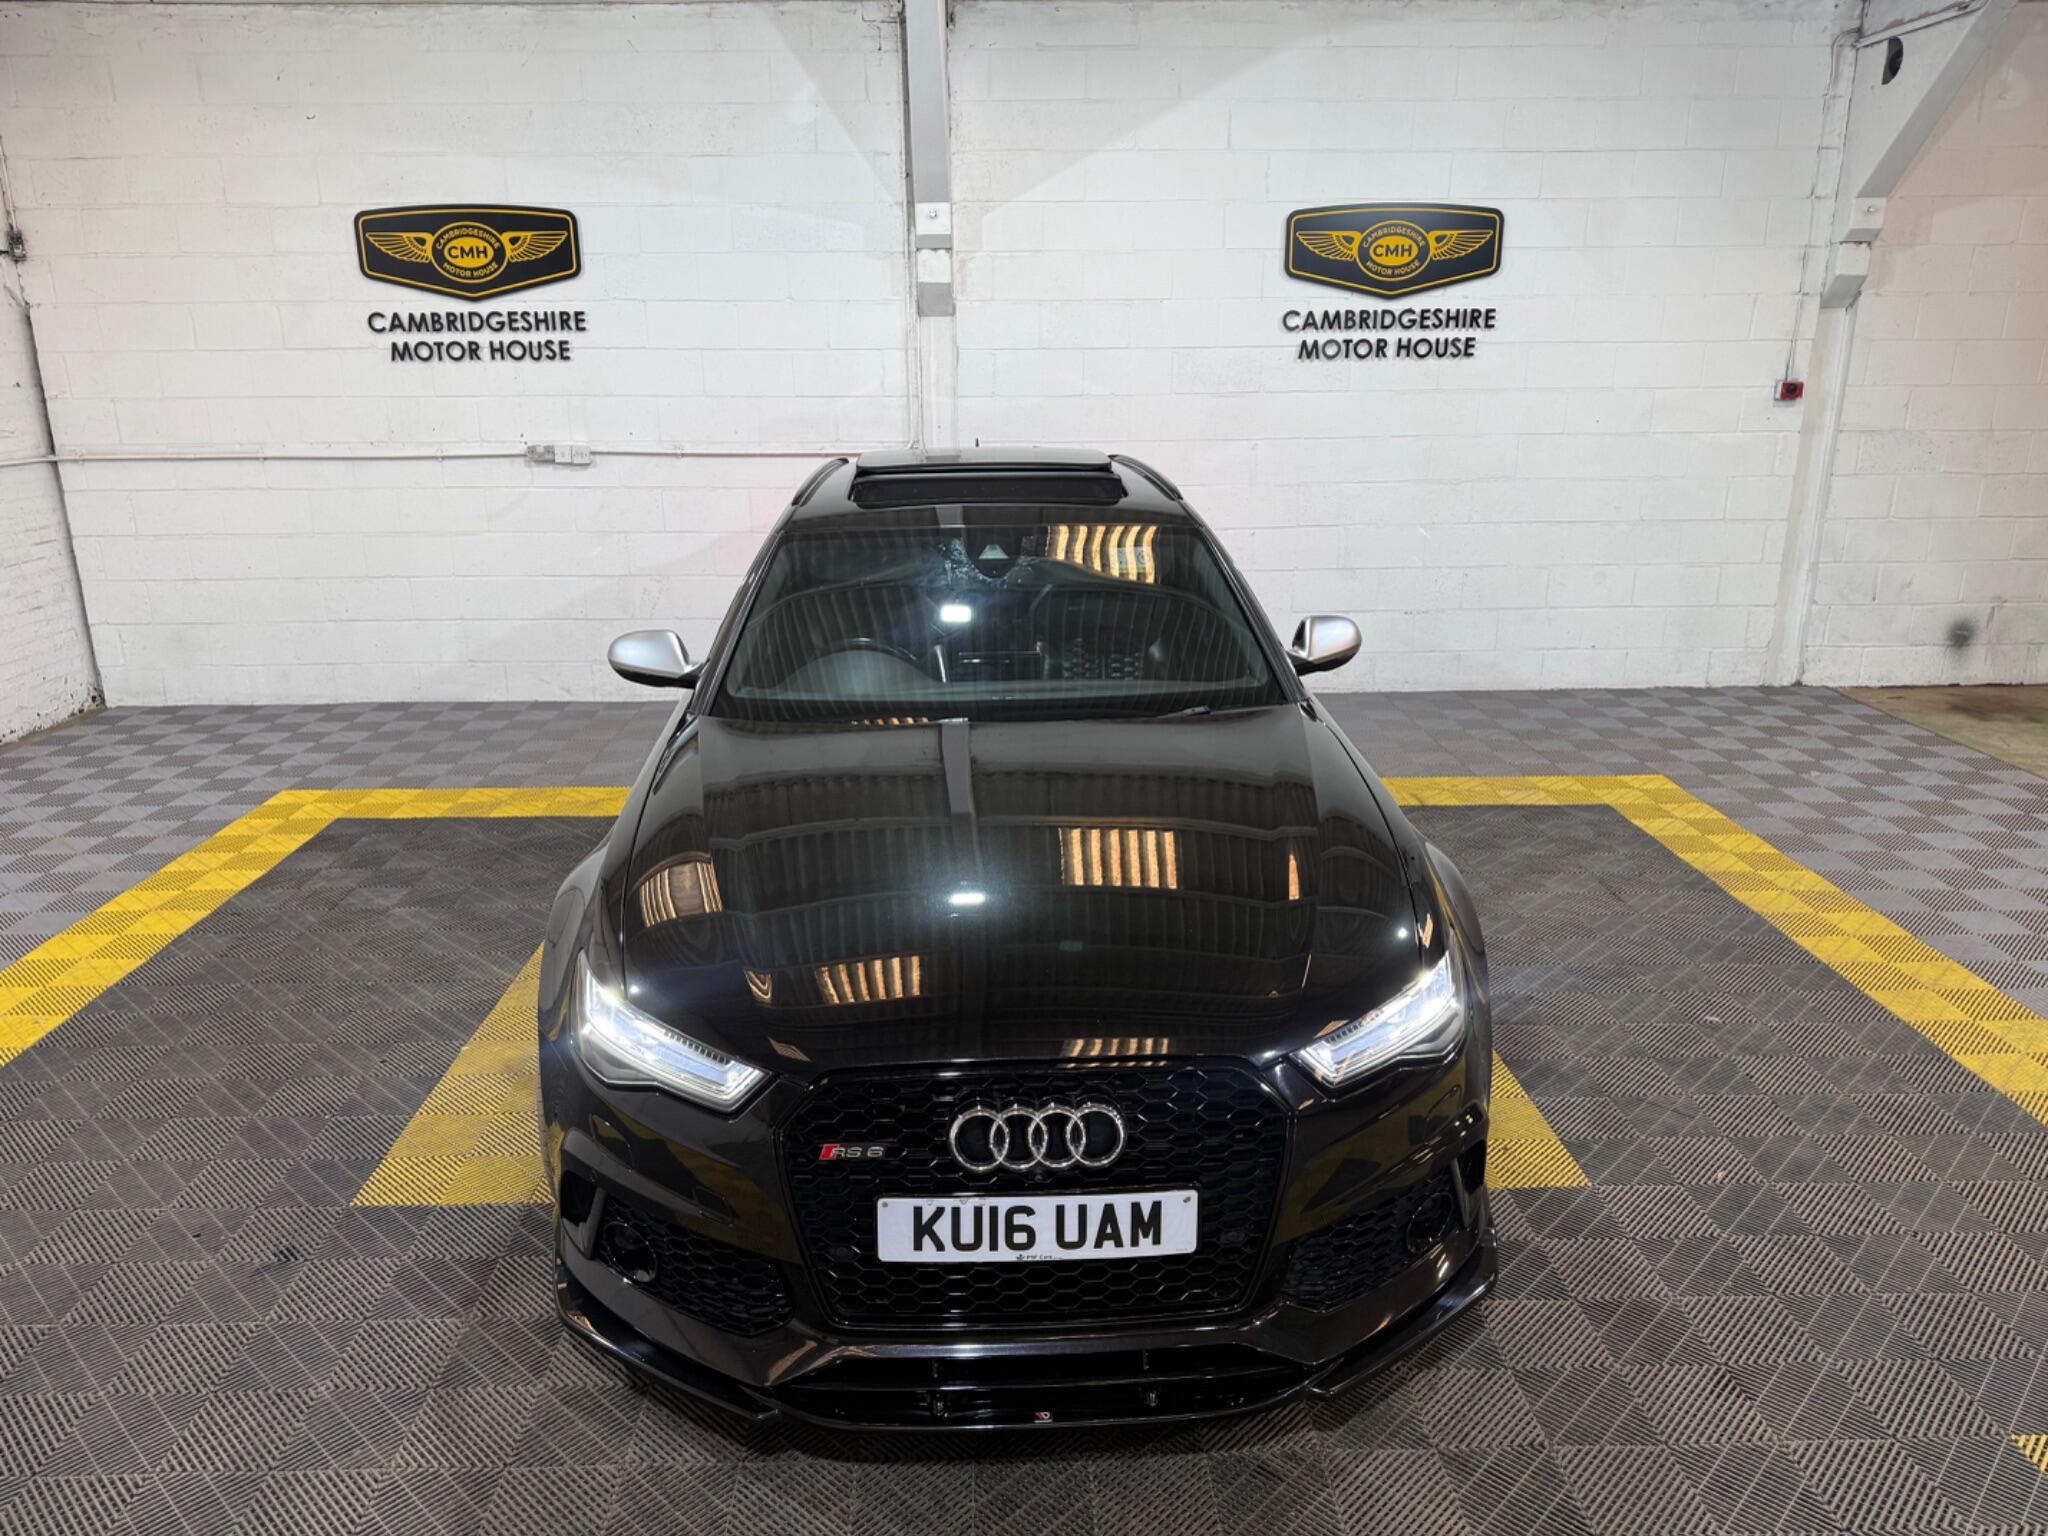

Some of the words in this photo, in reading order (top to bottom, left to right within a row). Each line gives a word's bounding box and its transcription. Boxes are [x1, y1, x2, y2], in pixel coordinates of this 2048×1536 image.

[436, 228, 500, 249] CAMBRIDGESHIRE
[1364, 226, 1425, 247] CAMBRIDGESHIRE
[448, 246, 488, 259] CMH
[1374, 244, 1412, 257] CMH
[443, 262, 472, 278] MOTOR
[473, 261, 498, 277] HOUSE
[1366, 259, 1393, 275] MOTOR
[1394, 259, 1420, 275] HOUSE
[368, 311, 587, 333] CAMBRIDGESHIRE
[1282, 308, 1497, 331] CAMBRIDGESHIRE
[391, 341, 481, 362] MOTOR
[490, 340, 571, 361] HOUSE
[1298, 338, 1388, 359] MOTOR
[1397, 337, 1477, 358] HOUSE
[913, 1205, 1036, 1252] KU16
[1056, 1201, 1162, 1251] UAM
